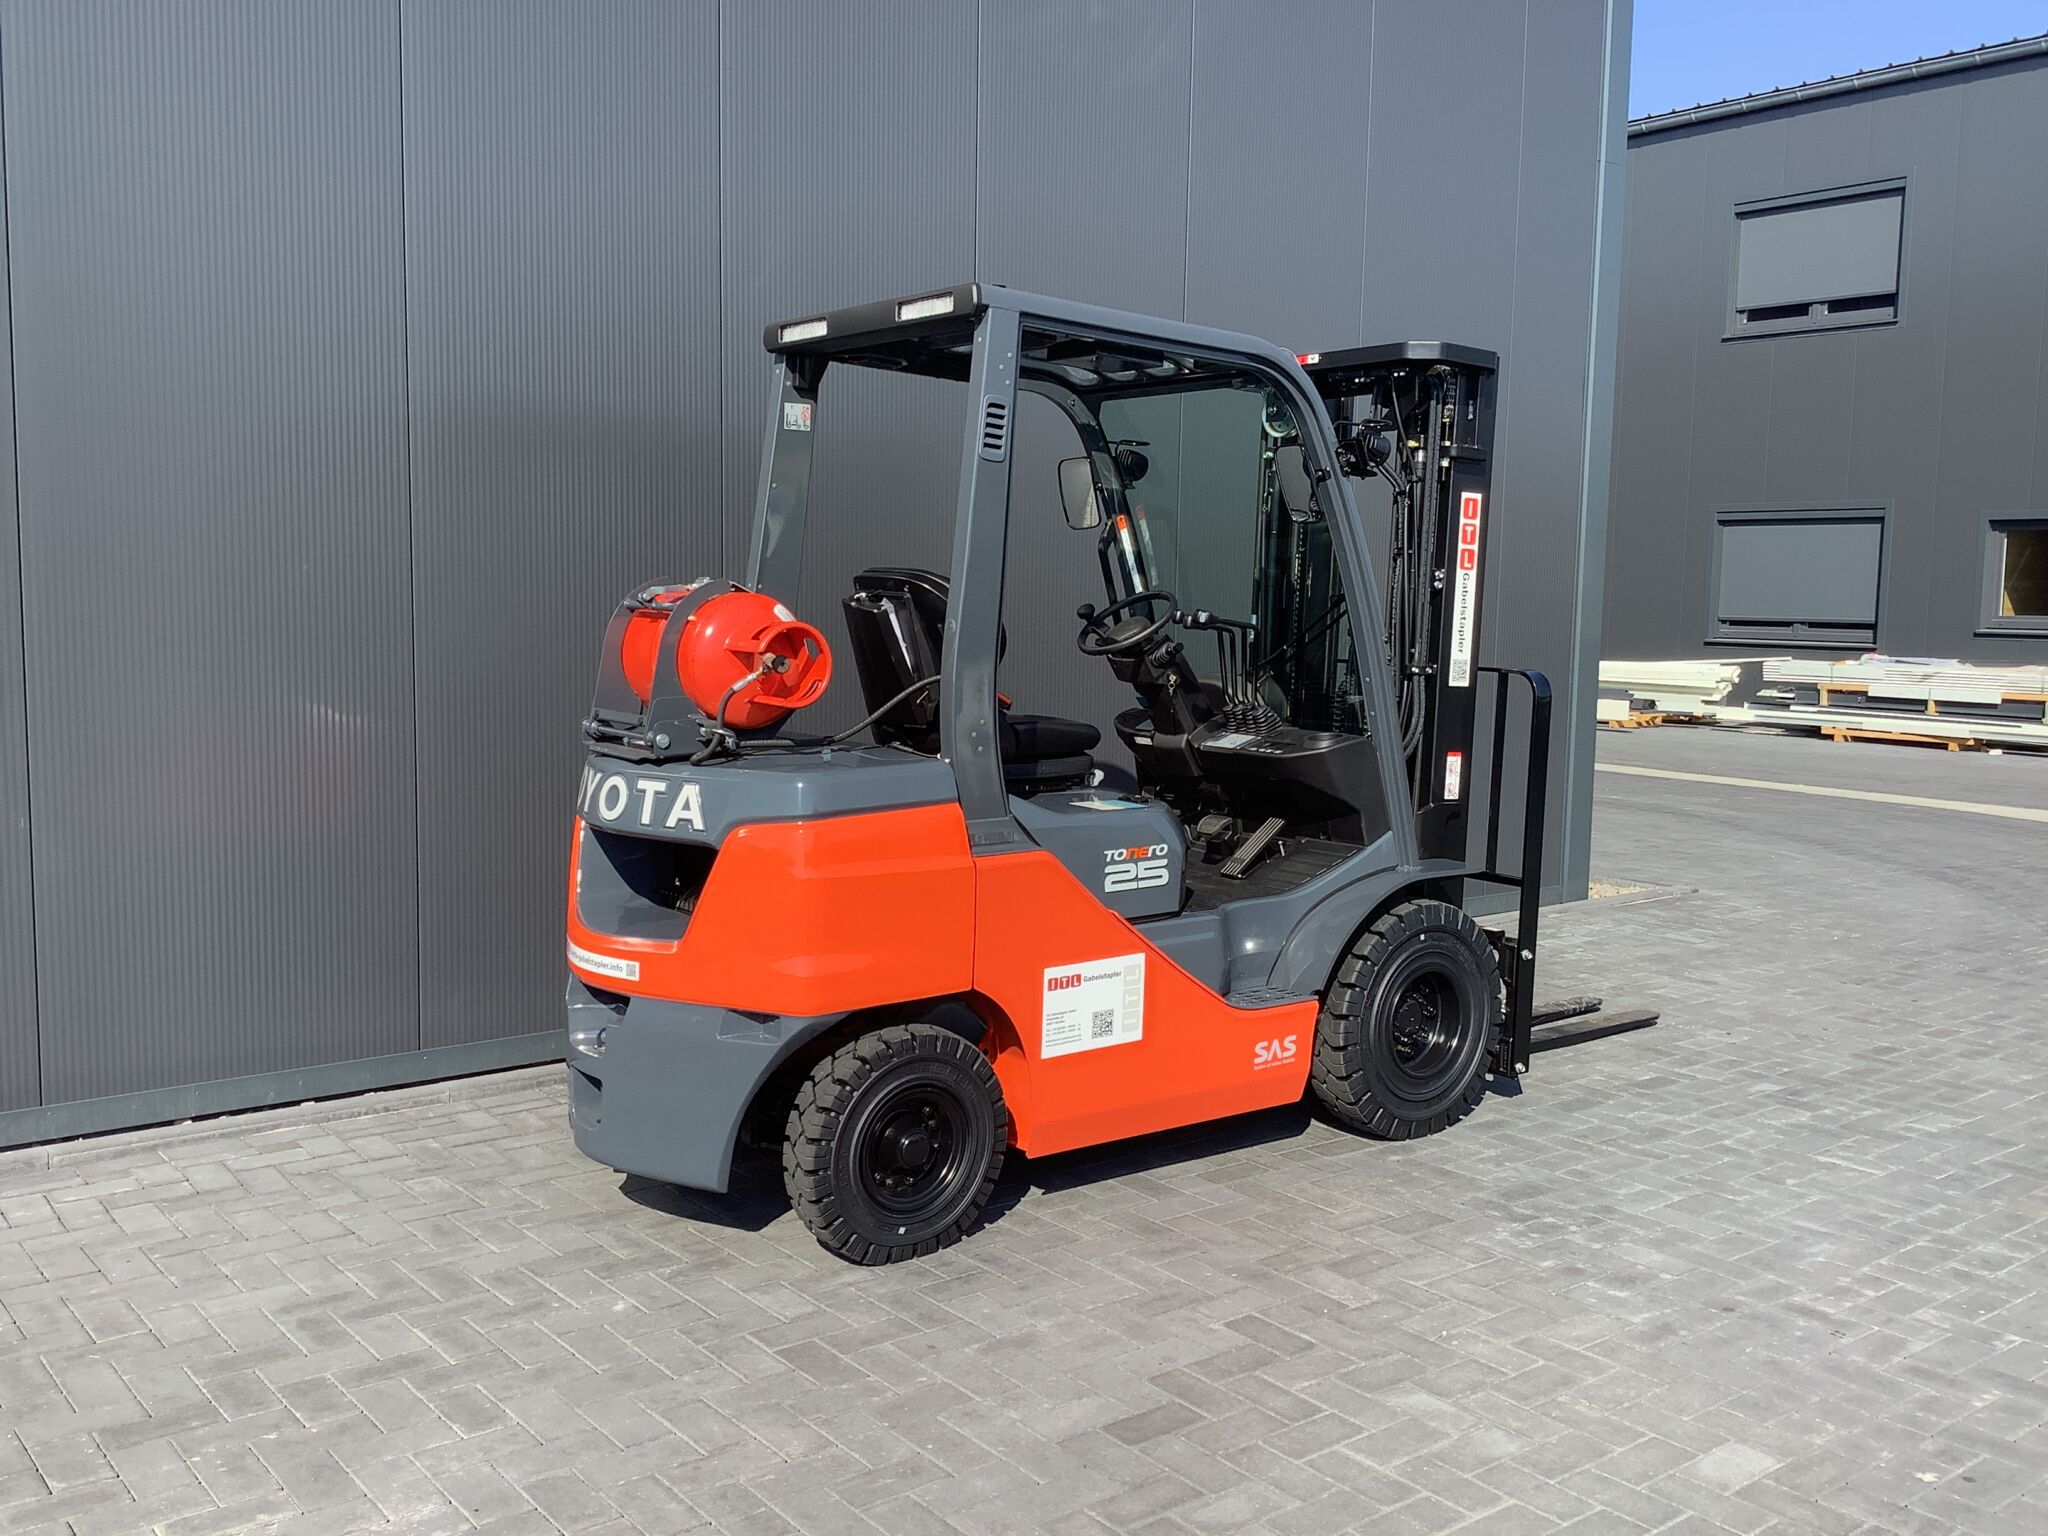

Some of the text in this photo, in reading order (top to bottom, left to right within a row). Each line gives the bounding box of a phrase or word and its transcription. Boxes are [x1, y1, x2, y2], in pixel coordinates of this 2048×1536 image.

[1457, 499, 1477, 653] ITL Gabelstapler
[1104, 859, 1169, 892] 25
[1049, 971, 1122, 990] ITL Gabelstapler
[1254, 1035, 1296, 1064] SAS
